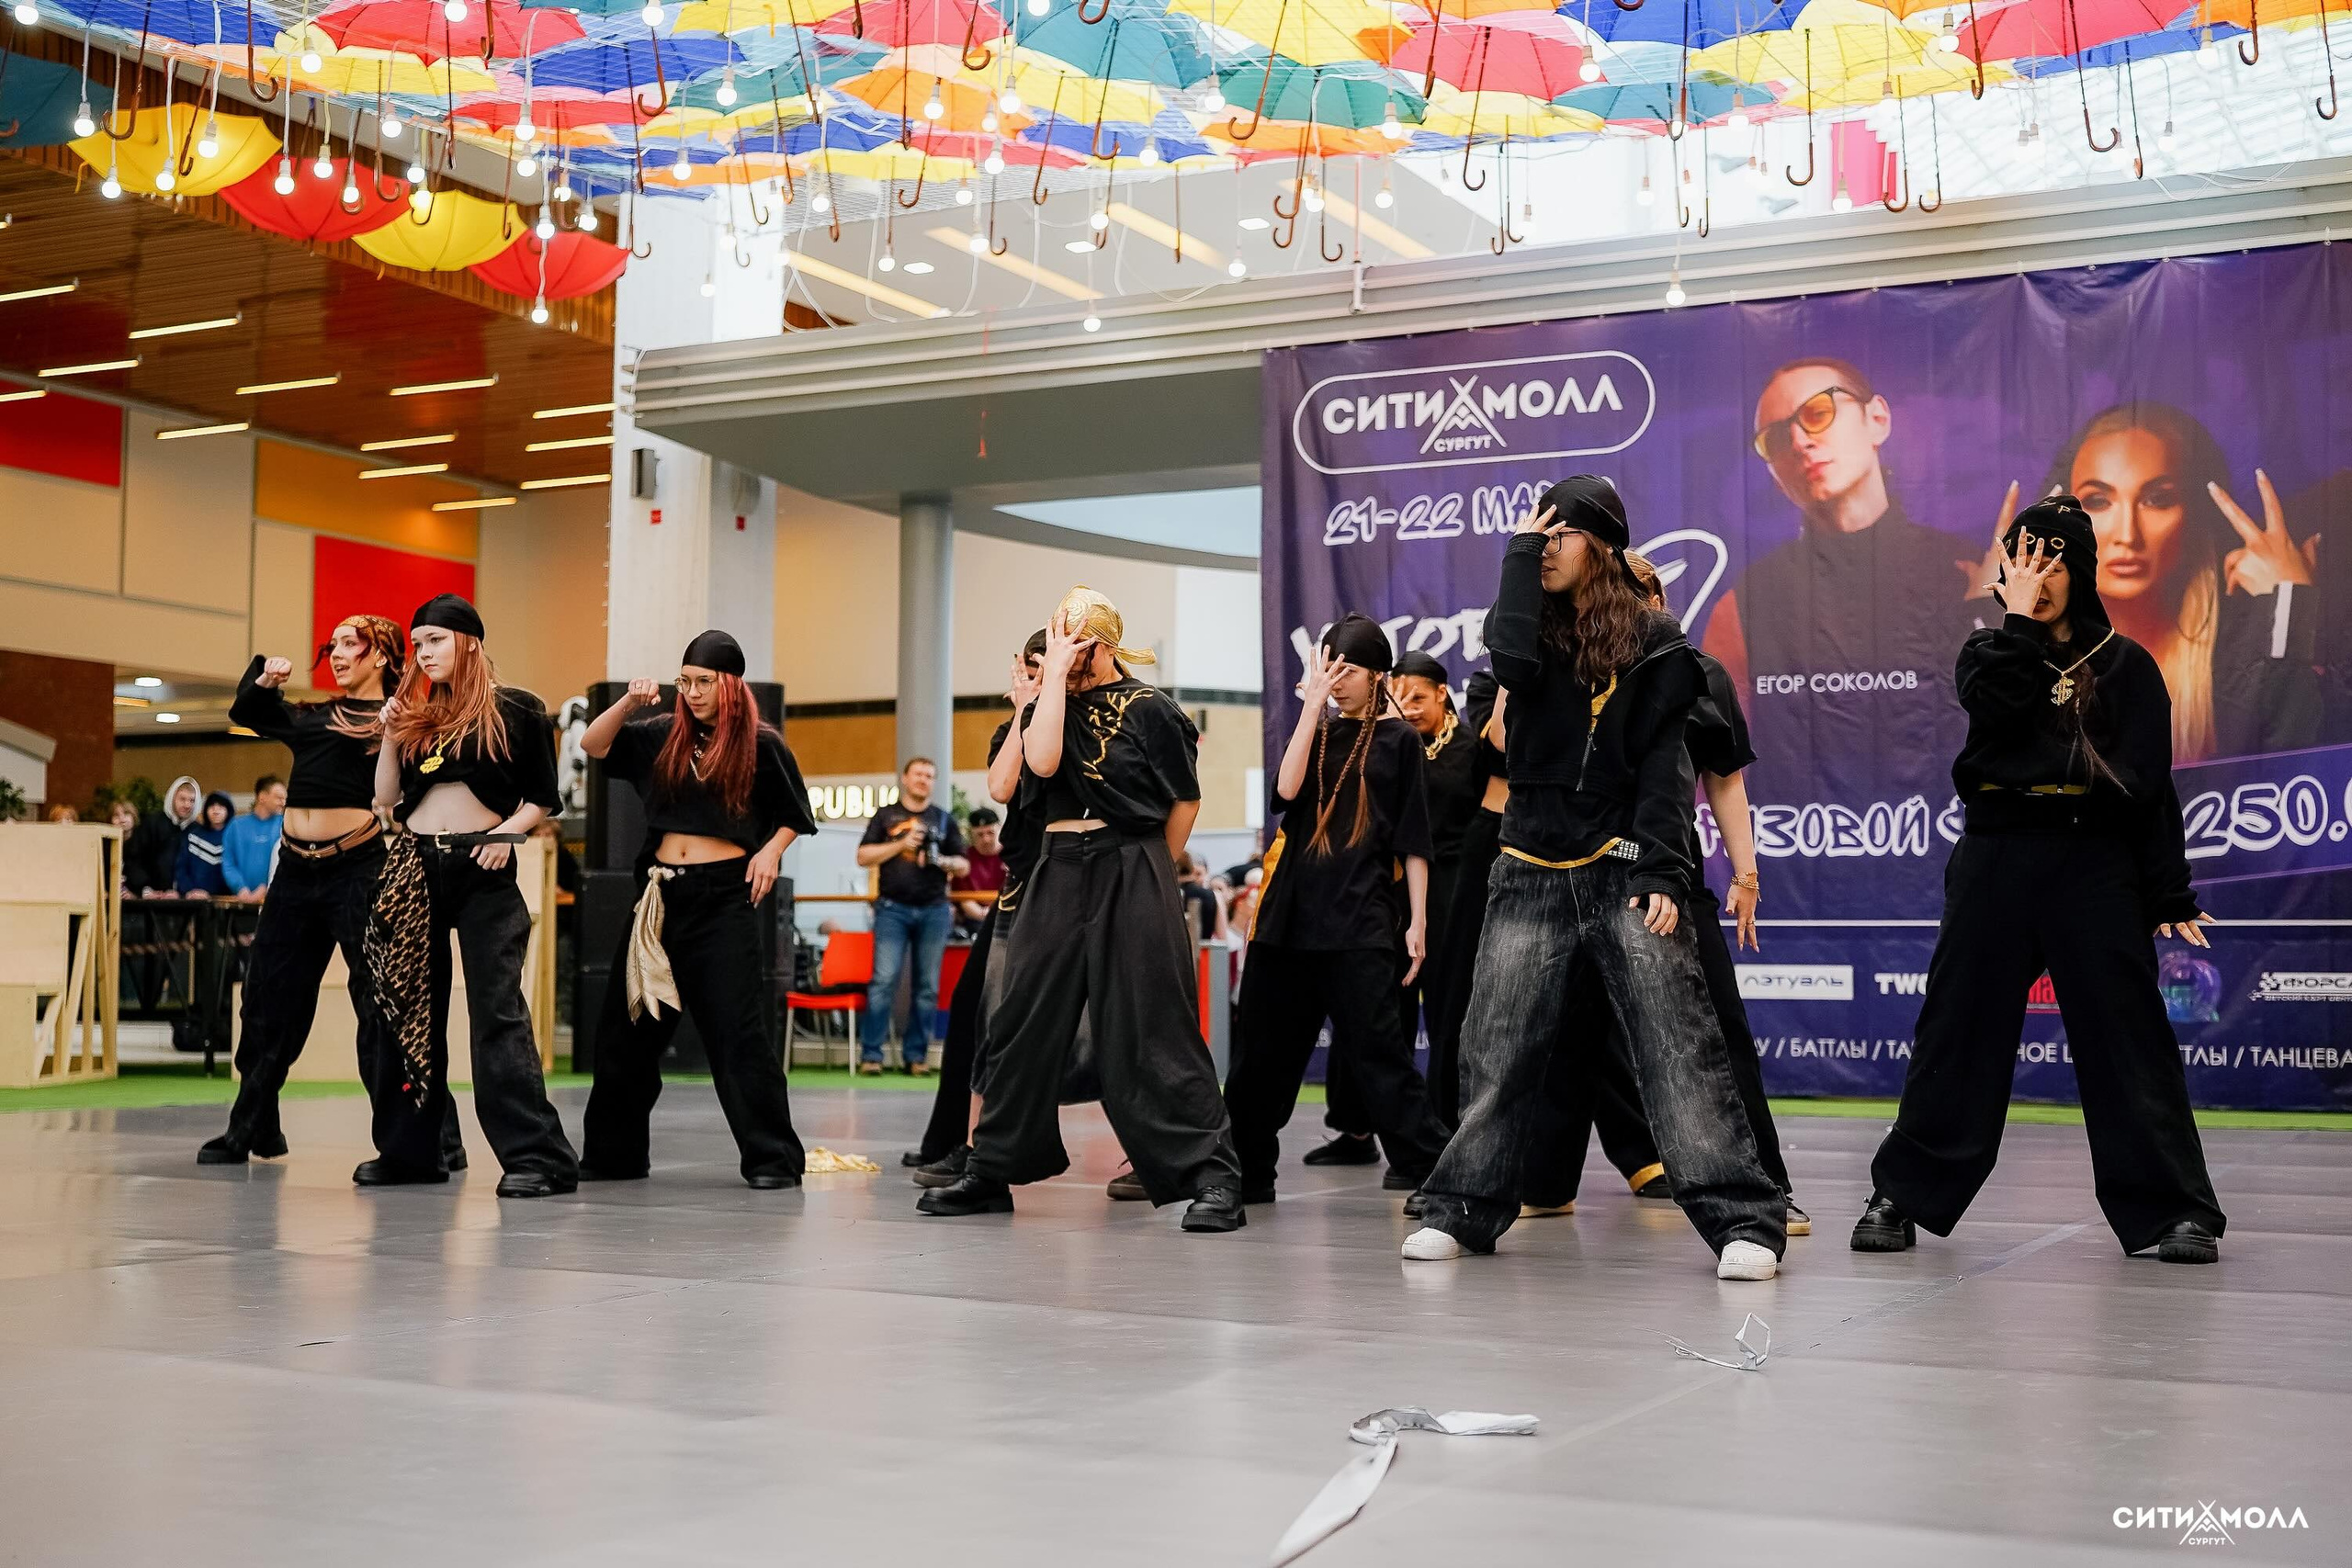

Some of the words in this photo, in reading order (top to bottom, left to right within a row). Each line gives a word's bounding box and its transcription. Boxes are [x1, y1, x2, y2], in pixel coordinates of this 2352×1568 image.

[1322, 389, 1446, 434] СИТИ
[1481, 373, 1624, 420] МОЛЛ
[1433, 434, 1495, 453] СУРГУТ
[1322, 492, 1464, 547] 21-22
[1756, 673, 1806, 694] ЕГОР
[1809, 670, 1919, 693] СОКОЛОВ
[2182, 774, 2352, 860] 250.
[2283, 976, 2352, 988] ФОРС
